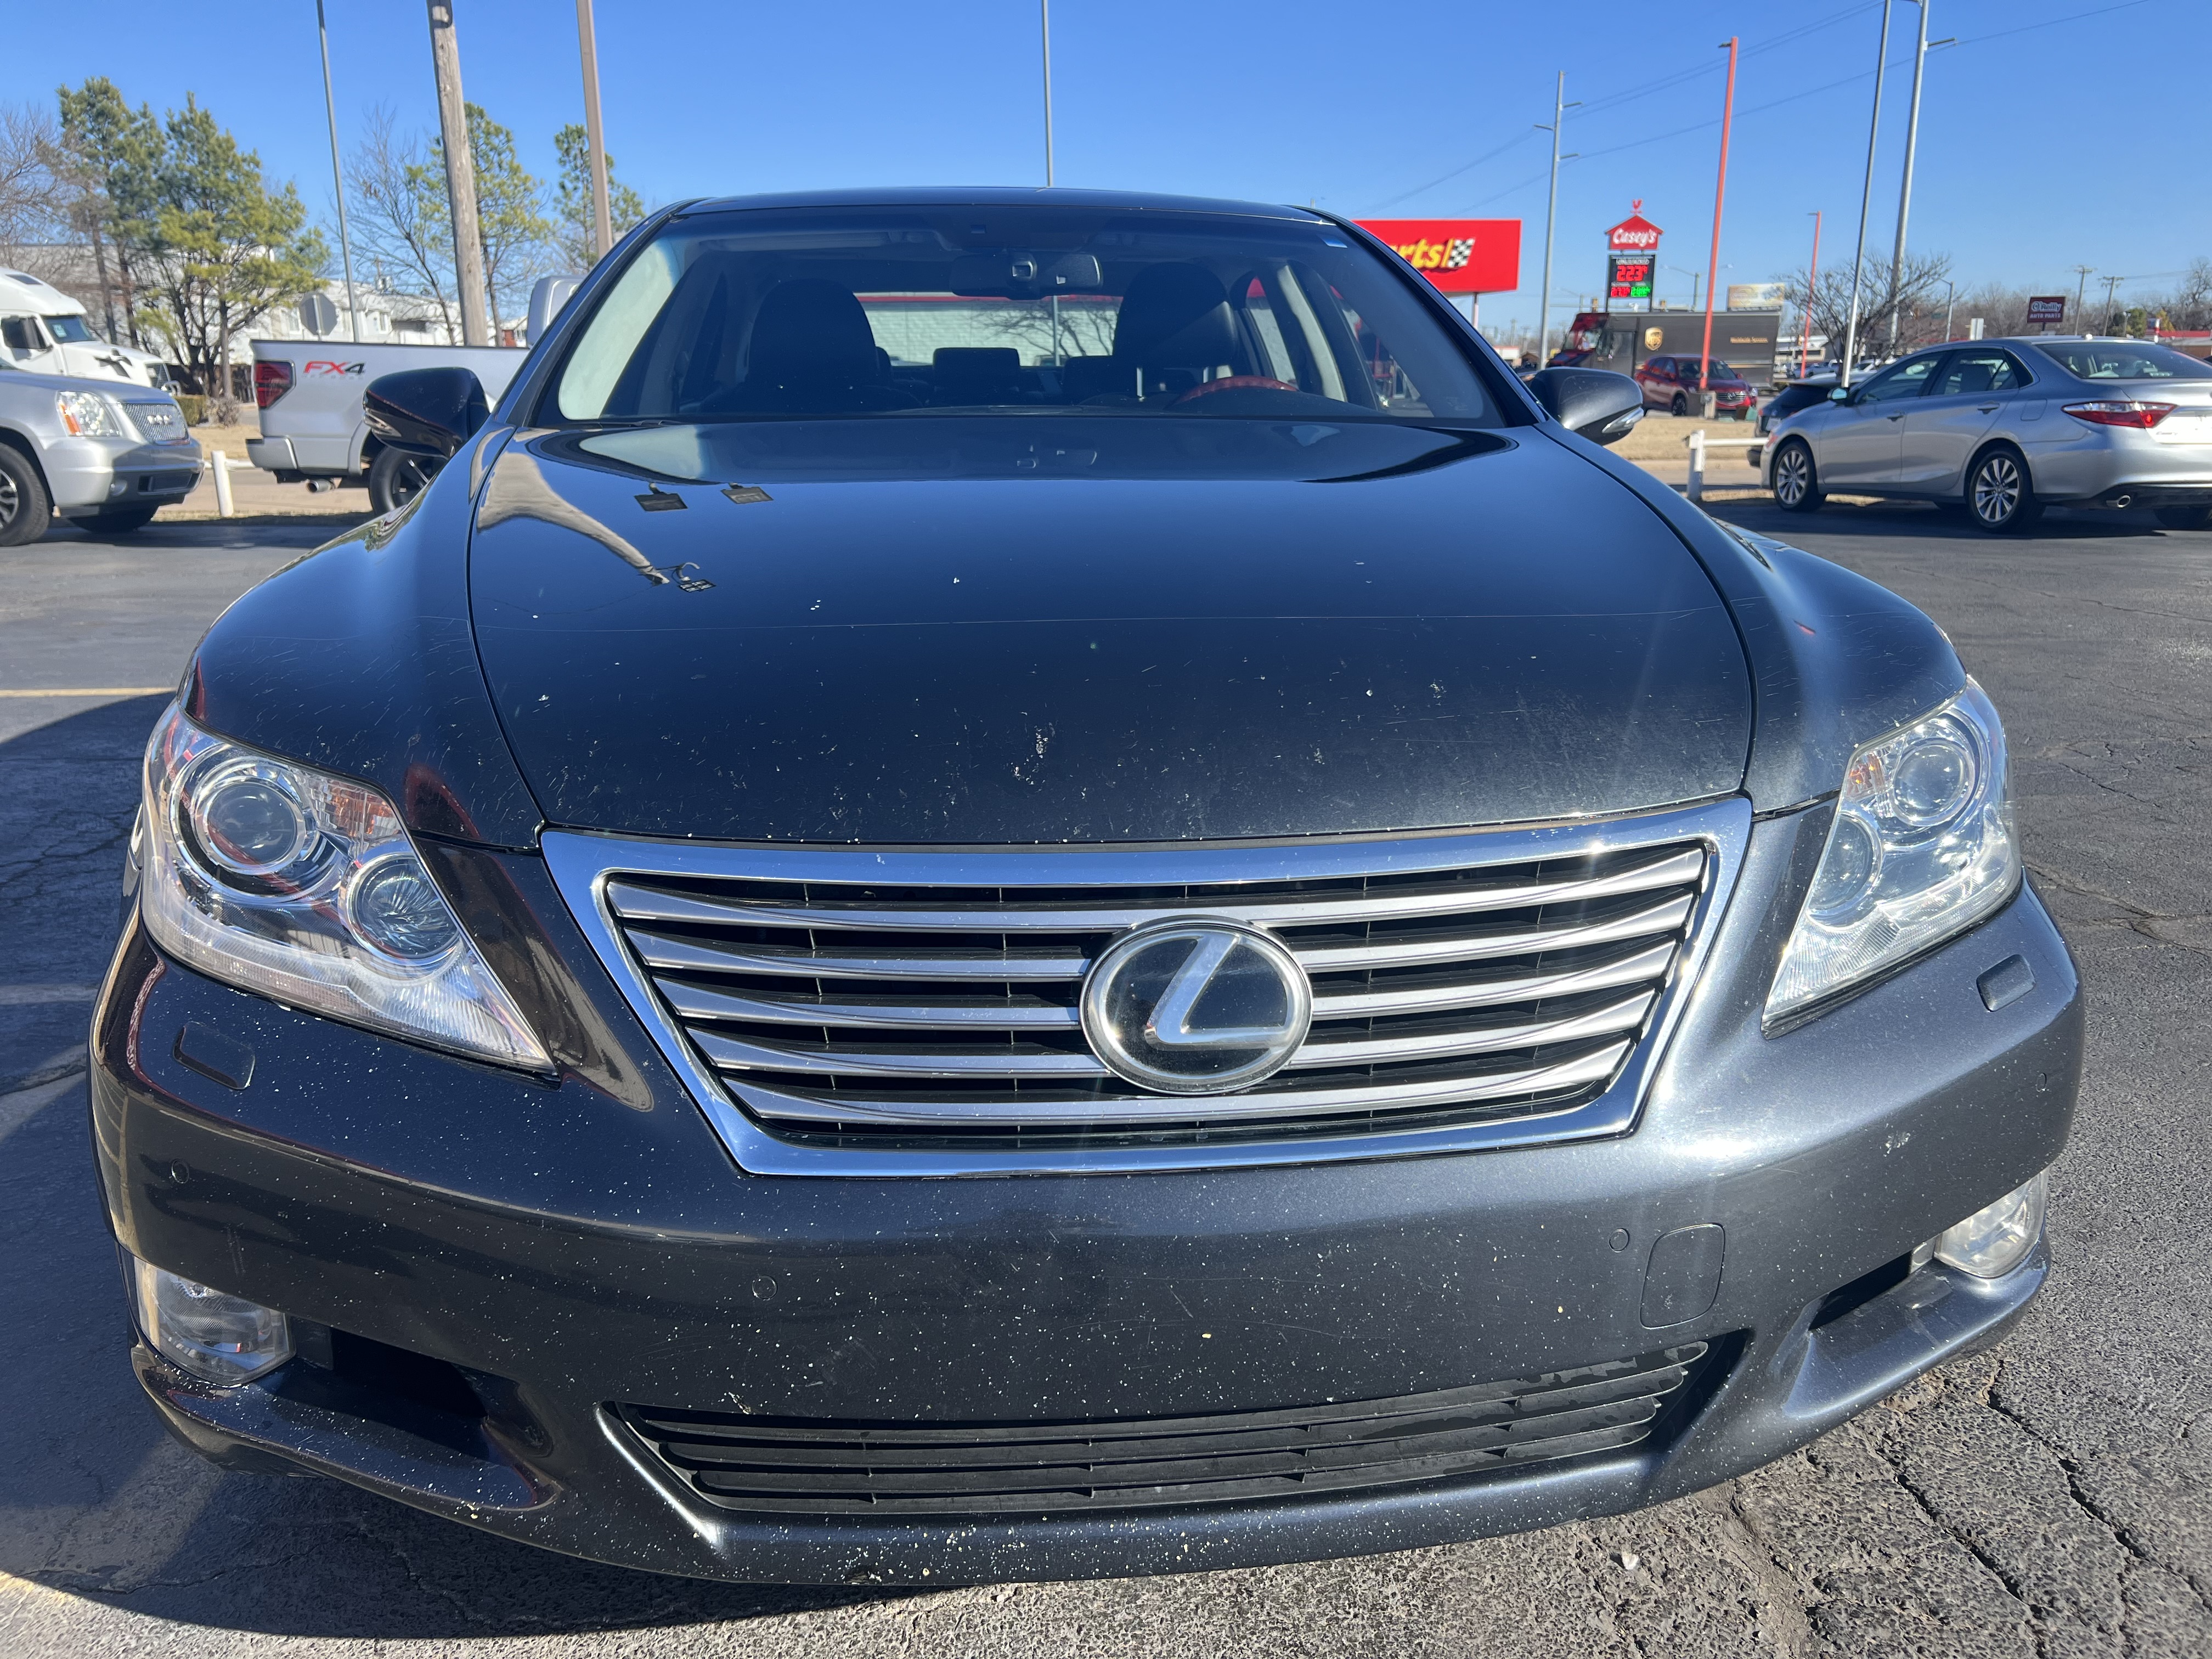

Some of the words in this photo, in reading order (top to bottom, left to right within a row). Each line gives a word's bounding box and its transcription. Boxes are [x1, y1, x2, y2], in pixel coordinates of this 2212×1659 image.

[1613, 228, 1657, 247] Casey's
[1389, 239, 1444, 268] rts
[303, 361, 366, 375] FX4
